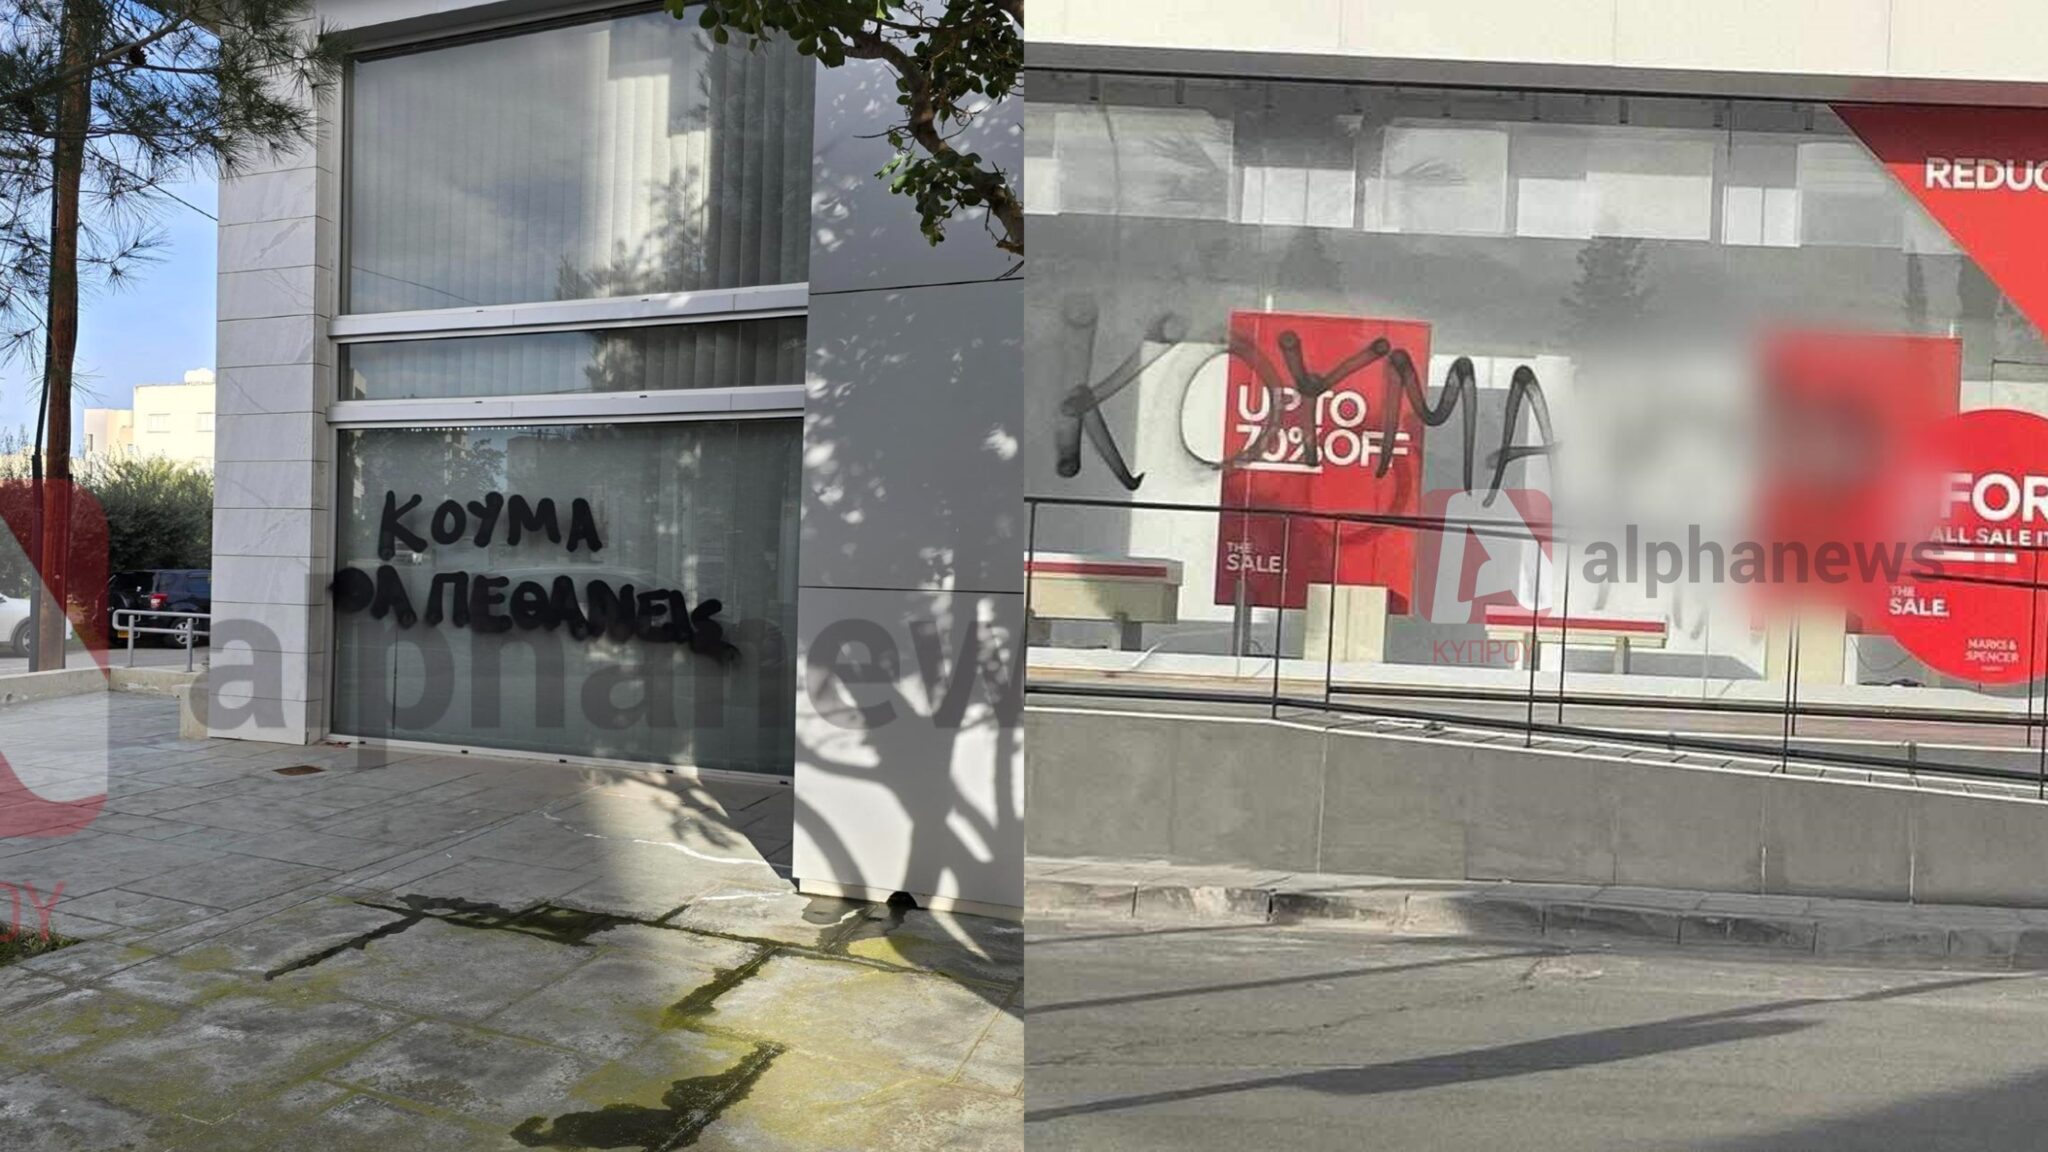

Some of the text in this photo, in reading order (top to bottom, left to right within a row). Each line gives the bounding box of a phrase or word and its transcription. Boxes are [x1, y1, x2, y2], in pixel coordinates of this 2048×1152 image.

[1238, 384, 1367, 428] UP TO
[1941, 473, 2048, 522] FOR
[1929, 525, 1971, 544] ALL
[1976, 528, 2031, 547] SALE
[1890, 586, 1916, 597] THE
